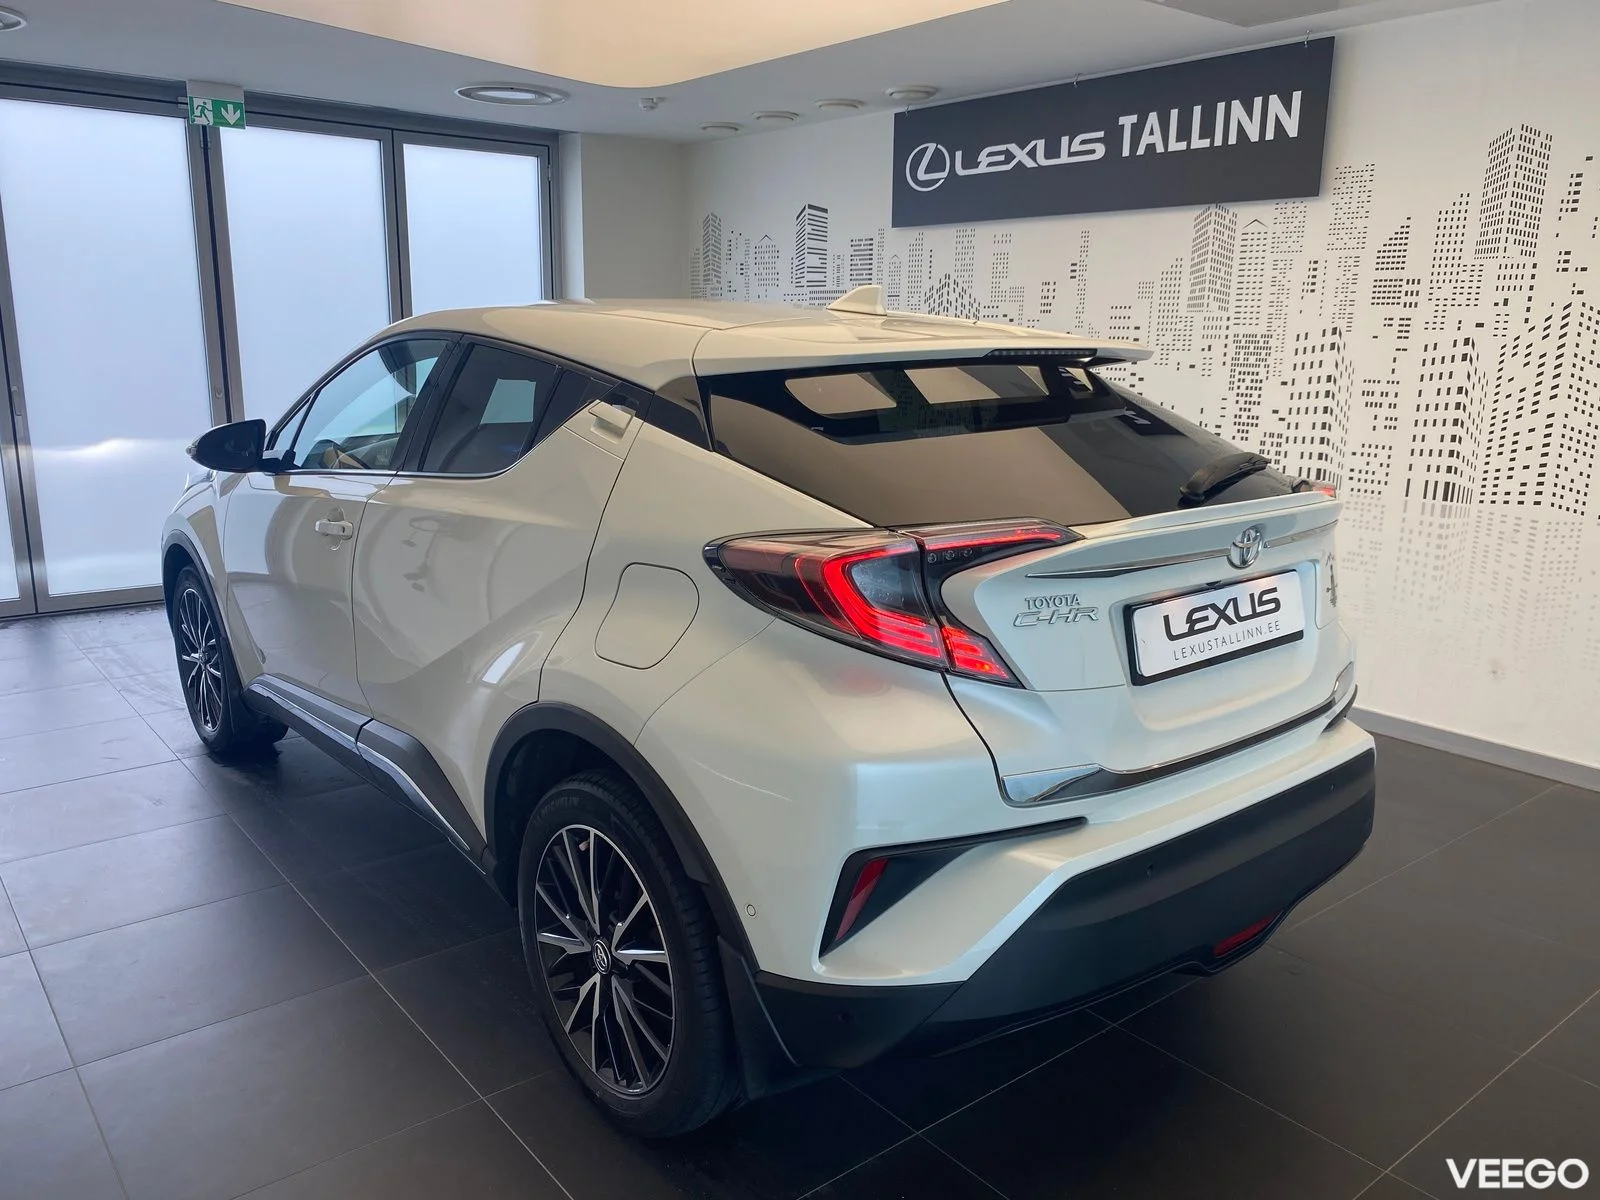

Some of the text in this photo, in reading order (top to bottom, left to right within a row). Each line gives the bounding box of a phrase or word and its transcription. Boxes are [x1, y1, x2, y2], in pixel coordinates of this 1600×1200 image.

[955, 90, 1302, 176] LEXUS TALLINN
[1013, 606, 1099, 627] C-HR
[1024, 593, 1081, 610] TOYOTA
[1162, 586, 1281, 642] LEXUS
[1173, 620, 1281, 661] LEXUSTALLINN.EE
